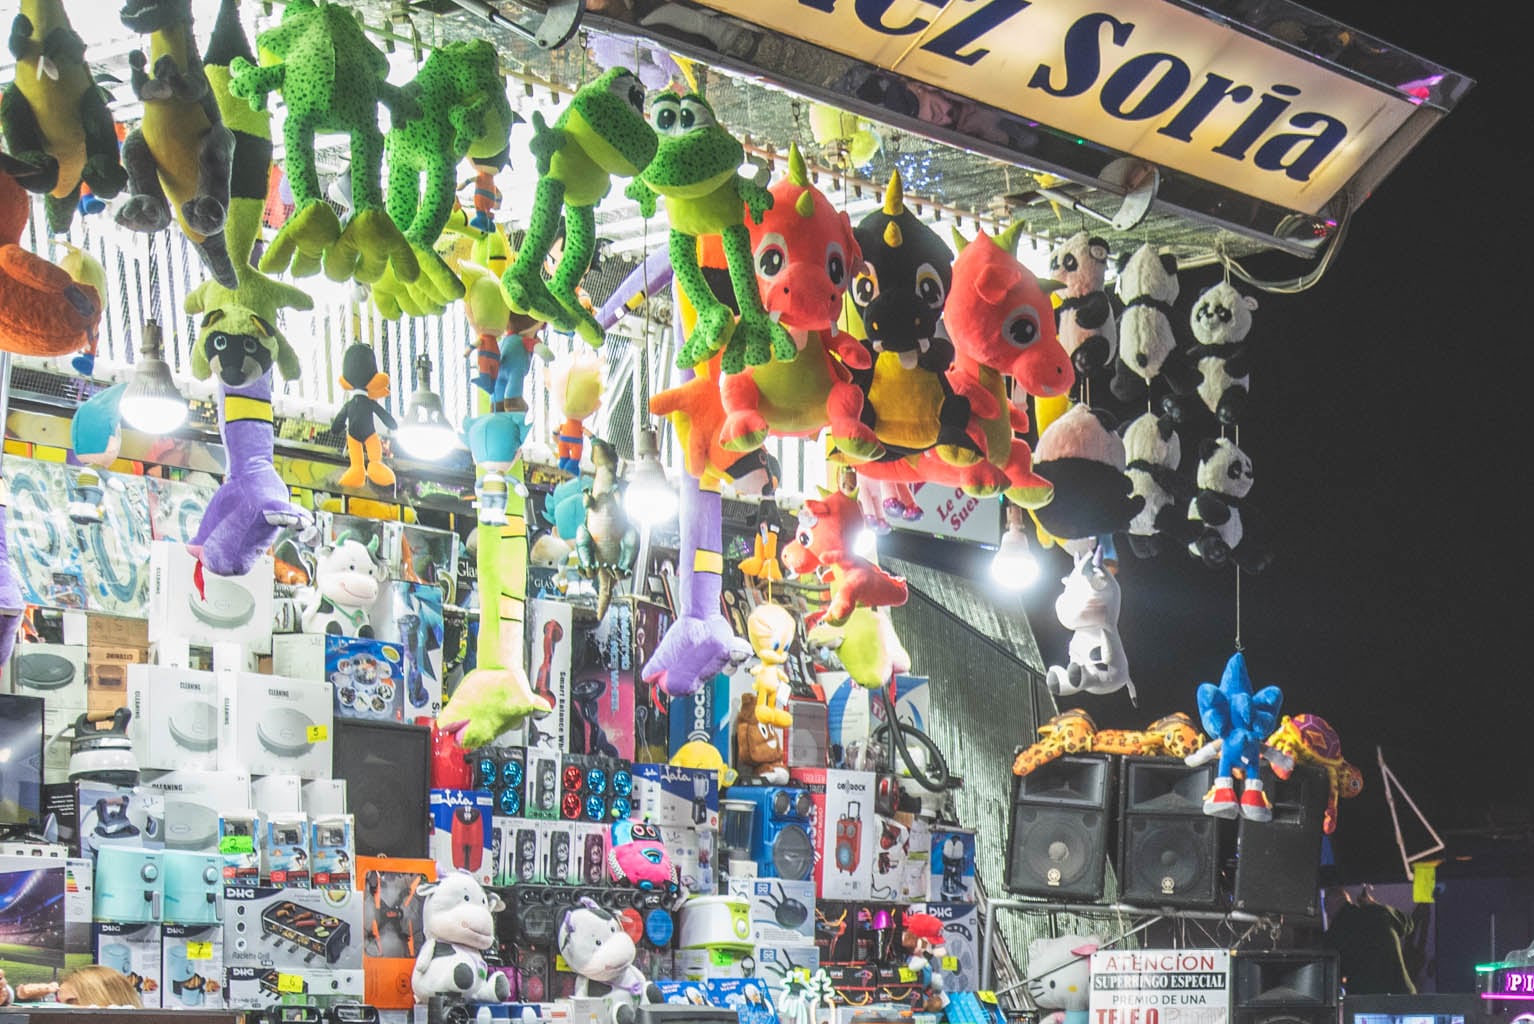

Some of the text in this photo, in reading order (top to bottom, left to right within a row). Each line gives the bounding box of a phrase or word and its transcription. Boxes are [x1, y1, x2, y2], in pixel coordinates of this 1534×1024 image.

[1027, 12, 1348, 182] Soria
[179, 681, 201, 691] CLEANING
[268, 688, 289, 698] CLEANING
[313, 727, 319, 737] 5
[660, 764, 691, 783] Jata
[440, 788, 474, 808] Jata
[226, 887, 255, 899] DHG
[929, 907, 953, 917] DHG
[102, 925, 121, 933] DHG
[166, 927, 185, 935] DHG
[232, 967, 255, 977] DHG
[1094, 973, 1225, 989] SUPERBINGO ESPECIAL
[1112, 995, 1206, 1005] PREMIO DE UNA
